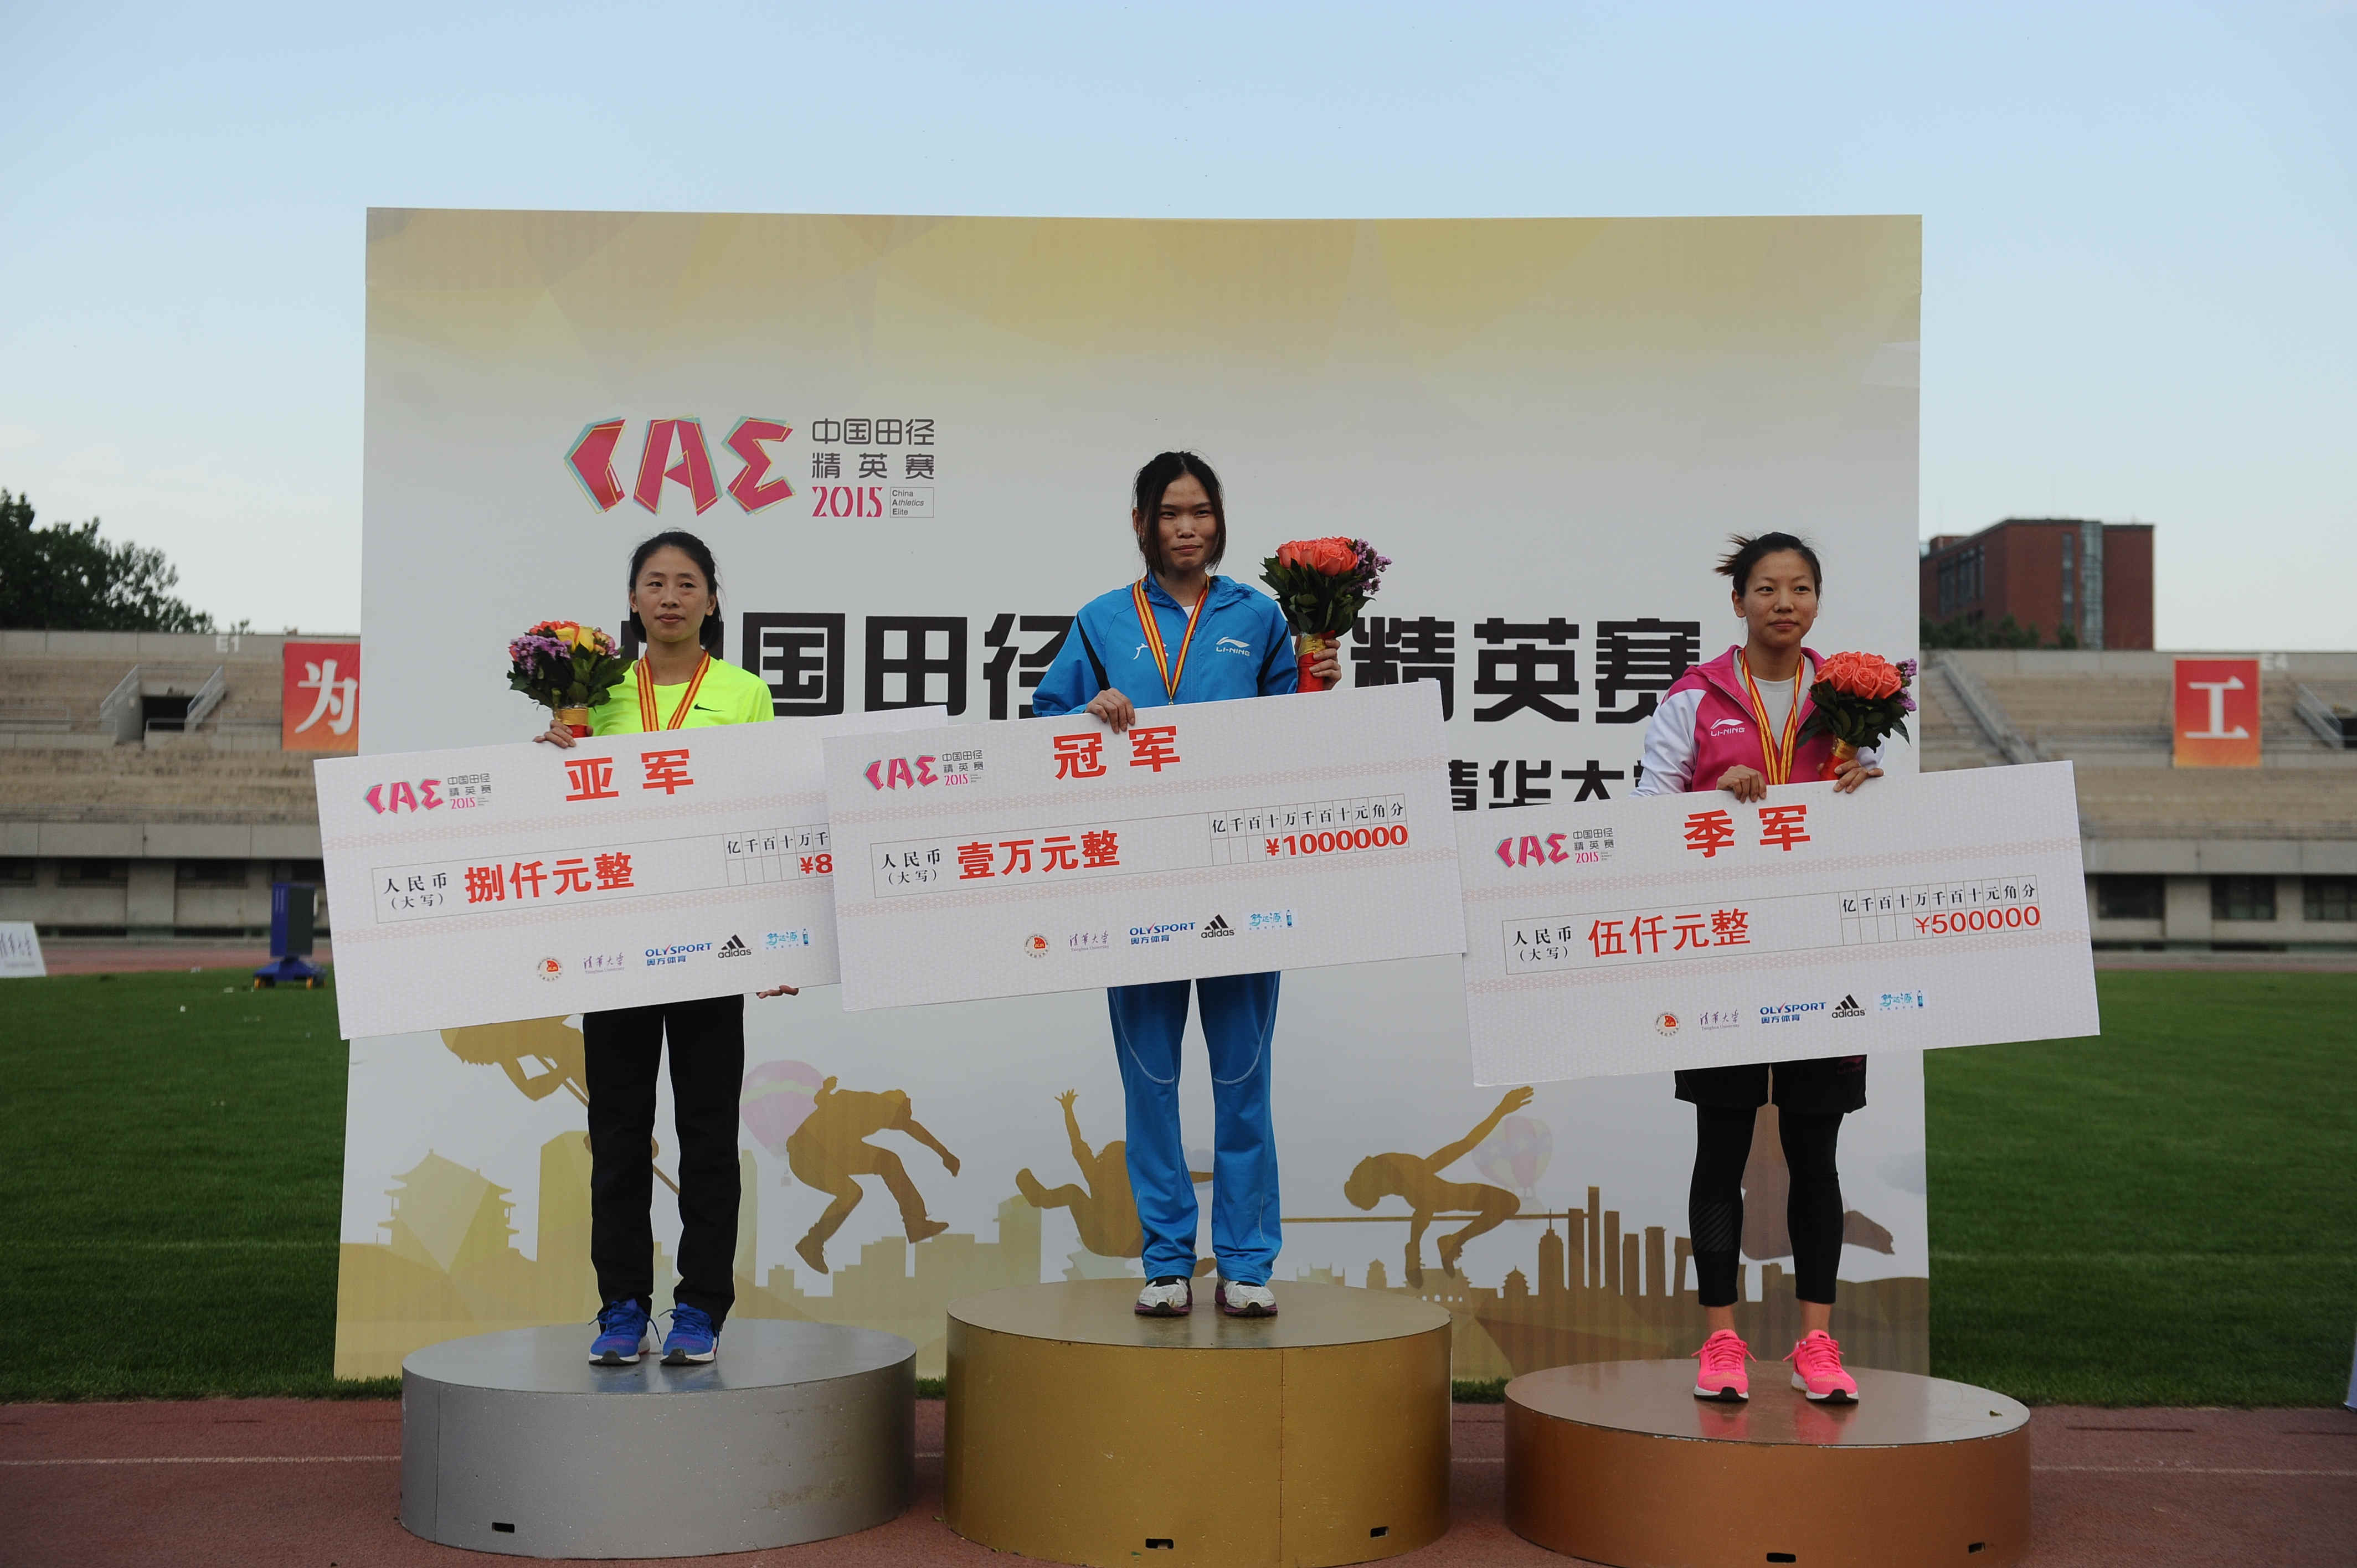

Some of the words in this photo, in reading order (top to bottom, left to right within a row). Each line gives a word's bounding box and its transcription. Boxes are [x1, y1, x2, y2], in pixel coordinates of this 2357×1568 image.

[812, 418, 935, 446] 中国田径
[812, 452, 935, 479] 精英赛
[812, 487, 883, 518] 2015
[1216, 646, 1250, 657] LI-NING
[294, 659, 358, 735] 为
[2183, 675, 2250, 739] 工
[1711, 728, 1745, 736] LI-NING
[942, 750, 983, 761] 中国田径
[1053, 725, 1181, 780] 冠军
[564, 750, 694, 802] 亚军
[944, 773, 969, 786] 2015
[451, 797, 476, 809] 2015
[1266, 825, 1408, 856] ¥1000000
[1573, 828, 1613, 839] 中国田径
[1684, 804, 1811, 858] 季军
[881, 848, 940, 869] 人民币
[957, 829, 1120, 880] 壹万元整
[1575, 851, 1600, 864] 2015
[384, 872, 447, 894] 人民币
[465, 852, 634, 904] 捌仟元整
[1130, 921, 1196, 936] OLYSPORT
[1915, 906, 2040, 934] ¥500000
[1201, 928, 1234, 938] adidas
[1512, 925, 1572, 946] 人民币
[1588, 908, 1751, 957] 伍仟元整
[645, 942, 712, 957] OLYSPORT
[718, 948, 752, 958] adidas
[1760, 1001, 1826, 1015] OLYSPORT
[1831, 1008, 1865, 1019] adidas
